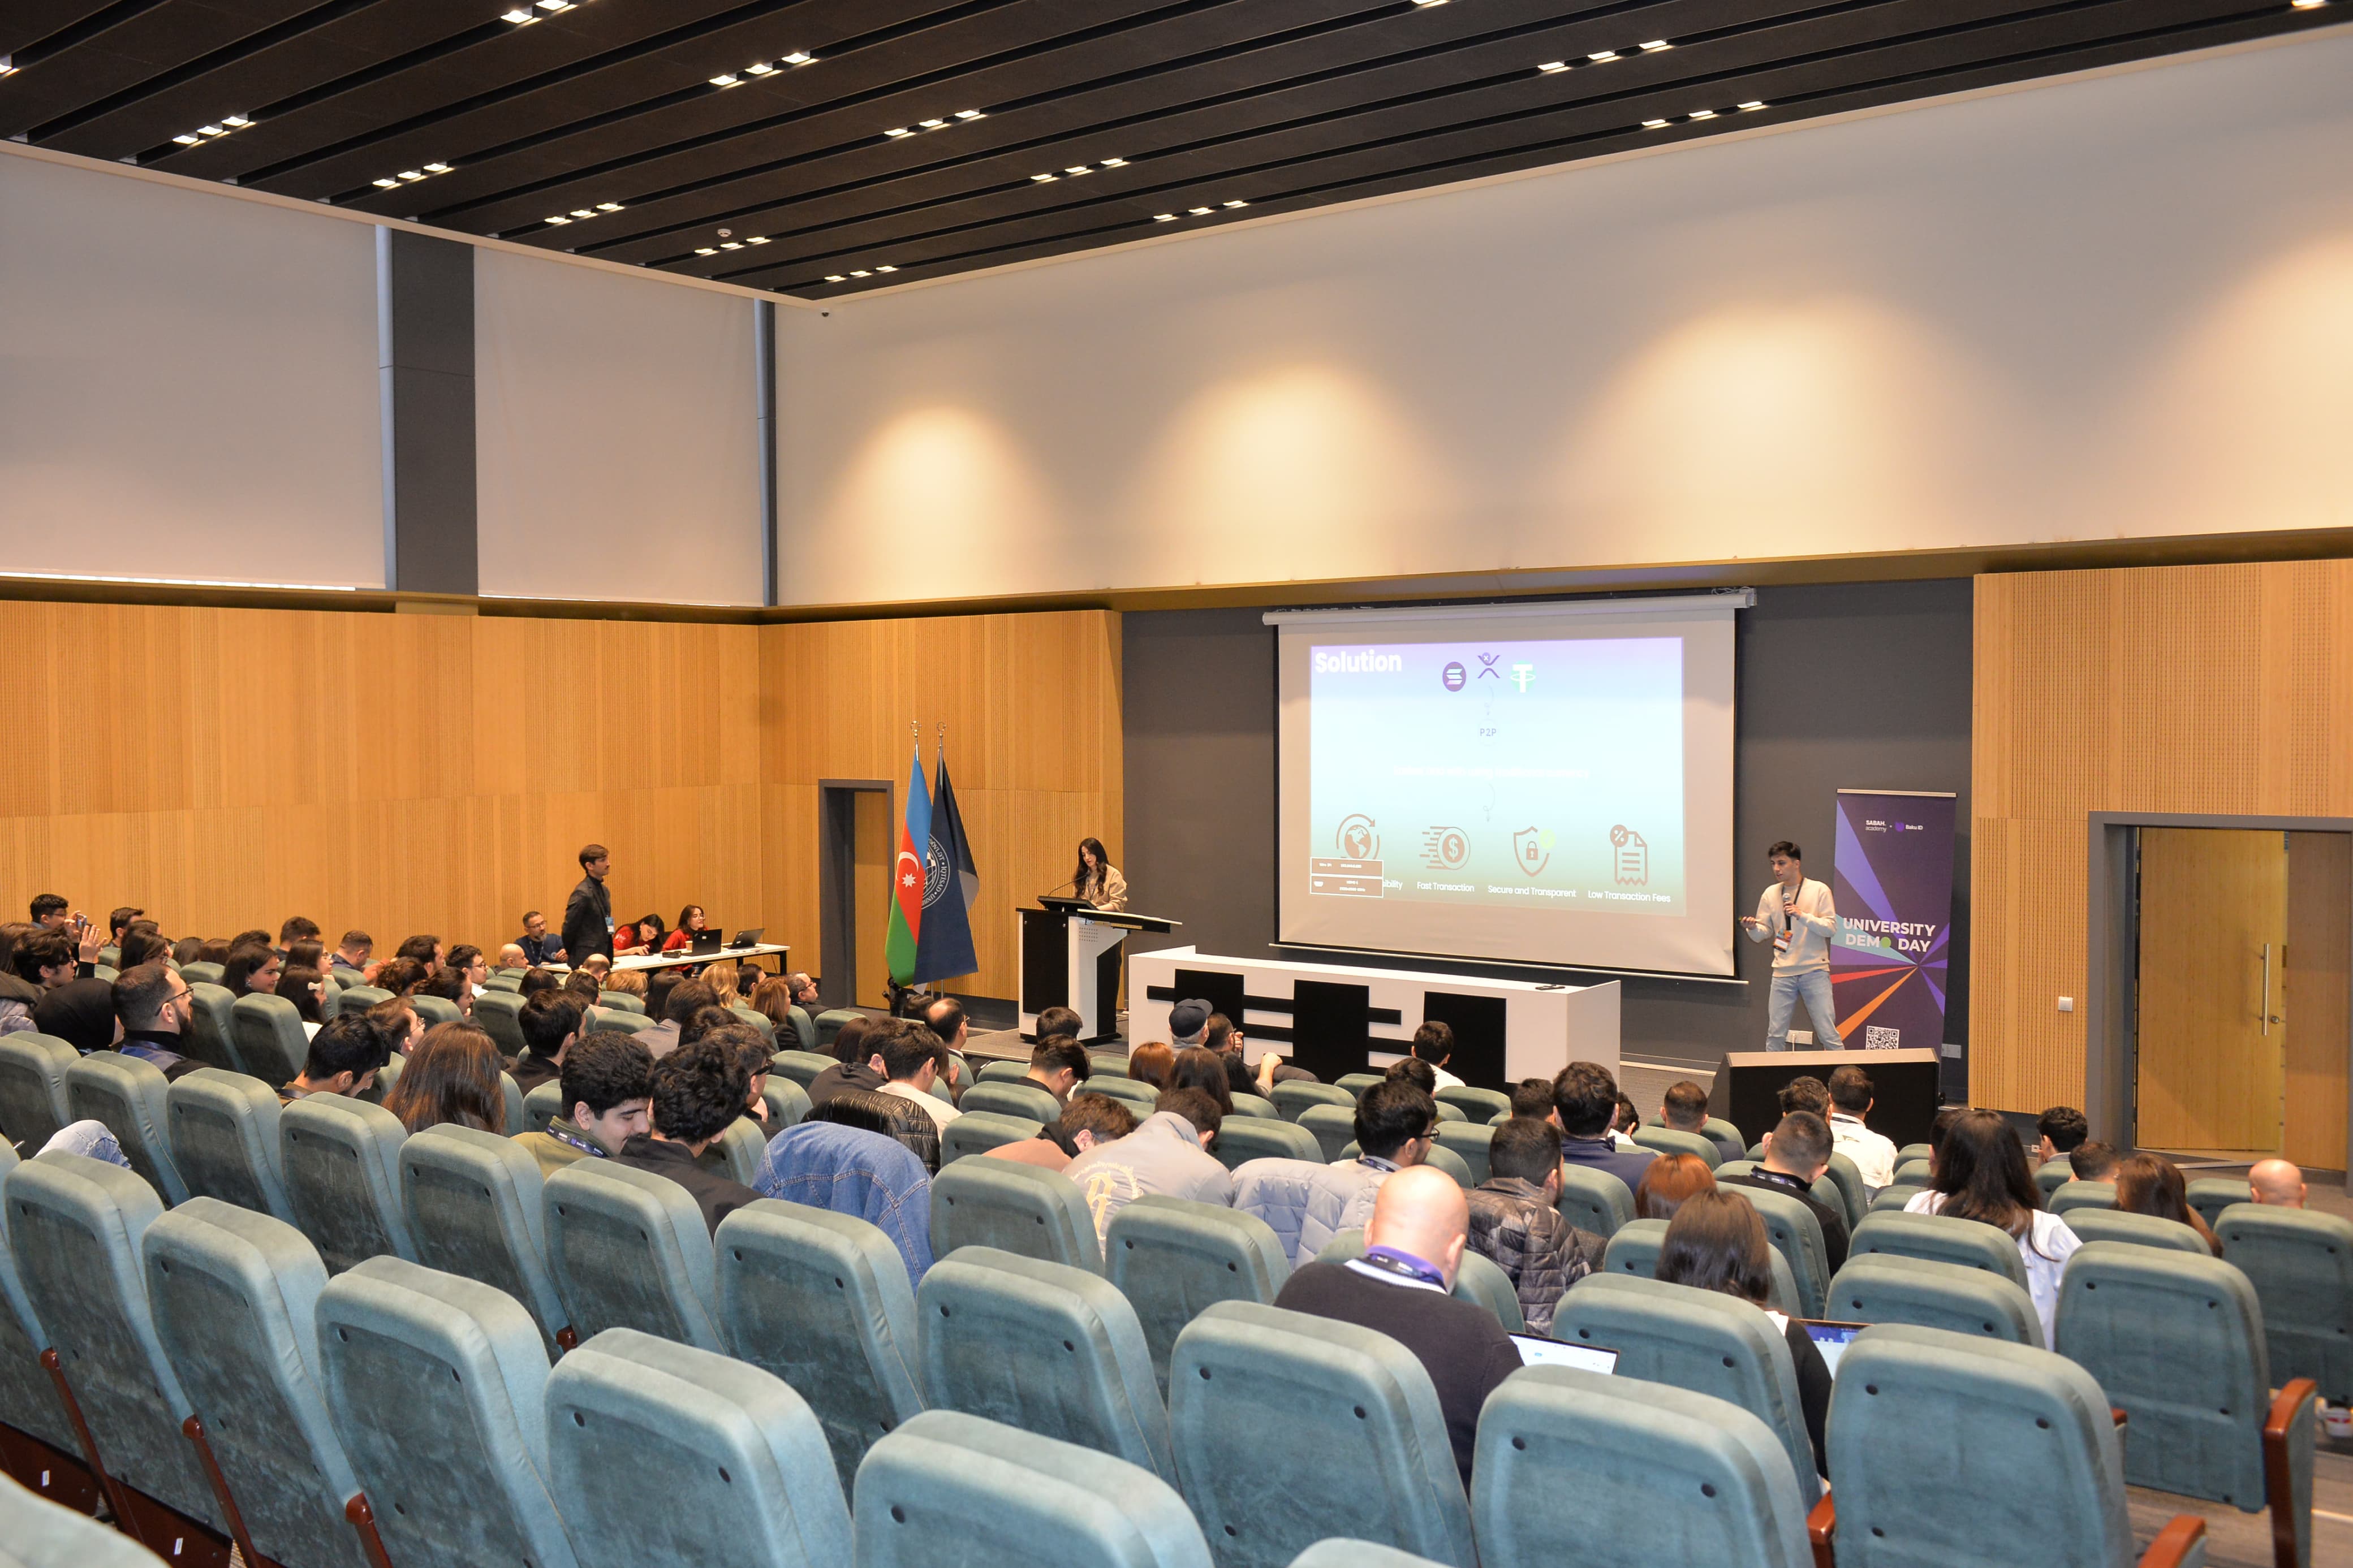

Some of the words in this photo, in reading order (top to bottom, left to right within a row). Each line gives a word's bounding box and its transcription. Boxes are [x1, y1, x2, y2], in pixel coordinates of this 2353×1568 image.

[1315, 649, 1402, 673] Solution
[1480, 728, 1497, 737] P2P
[1417, 882, 1432, 890] Fast
[1433, 882, 1475, 892] Transaction
[1488, 885, 1513, 894] Secure
[1514, 887, 1529, 895] and
[1531, 887, 1577, 899] Transparent
[1588, 890, 1603, 899] Low
[1604, 891, 1650, 901] Transaction
[1652, 893, 1671, 903] Fees
[1843, 917, 1936, 936] UNIVERSITY
[1898, 938, 1931, 952] DAY
